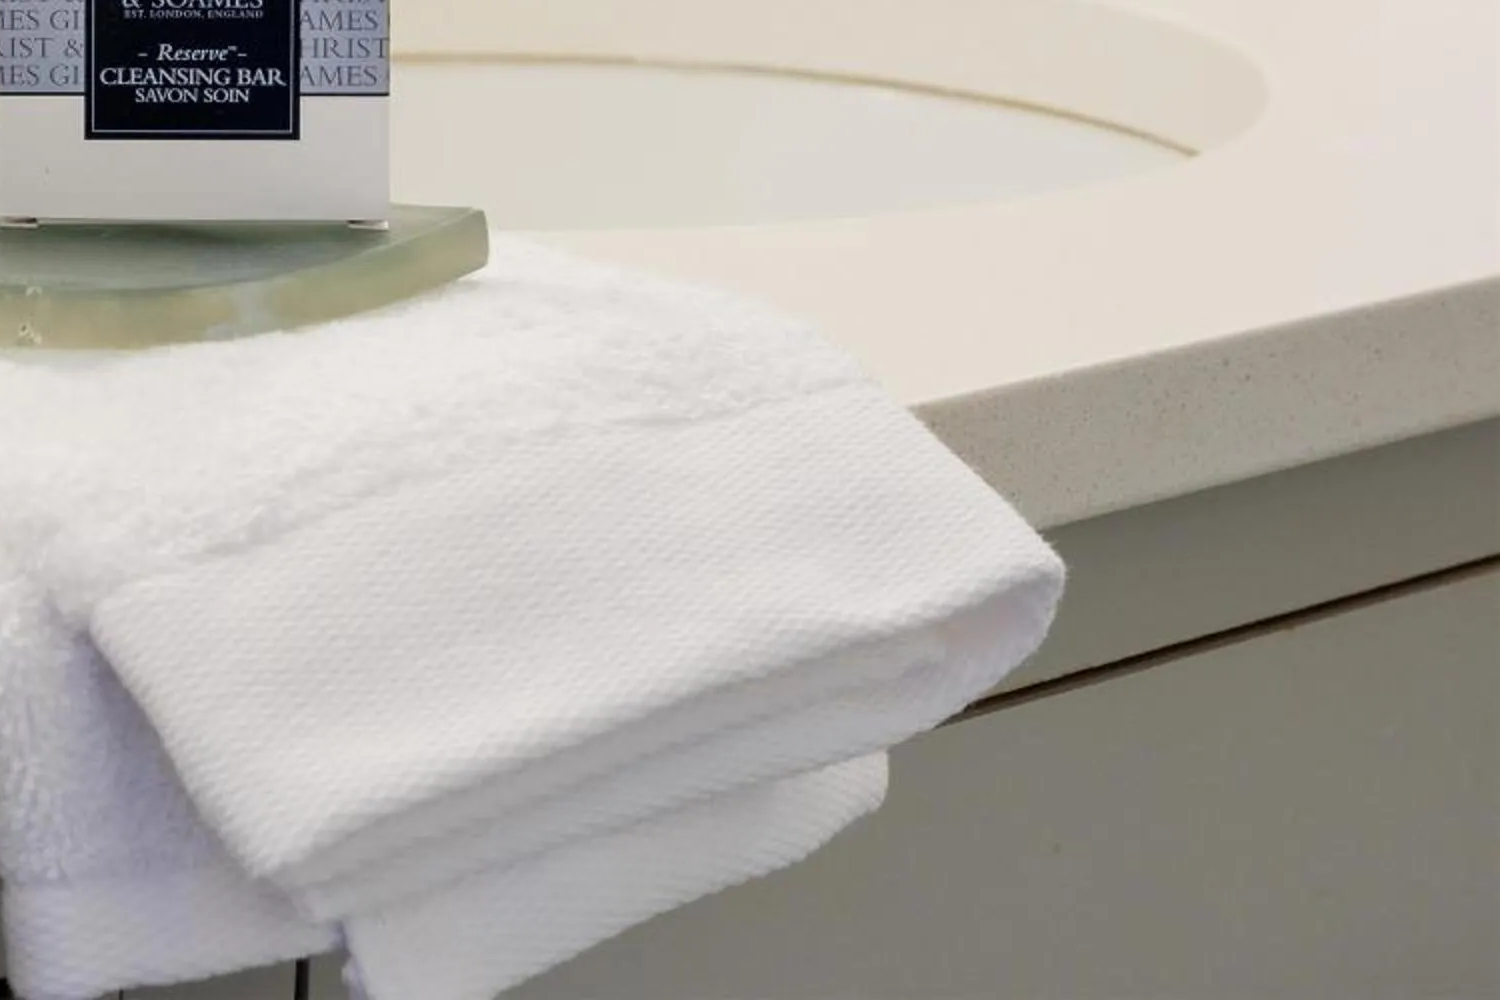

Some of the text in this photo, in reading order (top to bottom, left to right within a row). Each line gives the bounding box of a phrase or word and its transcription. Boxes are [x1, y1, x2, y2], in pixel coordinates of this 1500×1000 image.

[48, 8, 79, 31] GI
[206, 9, 264, 19] ENGLAND
[63, 37, 83, 59] &
[48, 63, 79, 87] GI
[99, 66, 288, 87] CLEANSING BAR
[134, 87, 250, 104] SAVON SOIN
